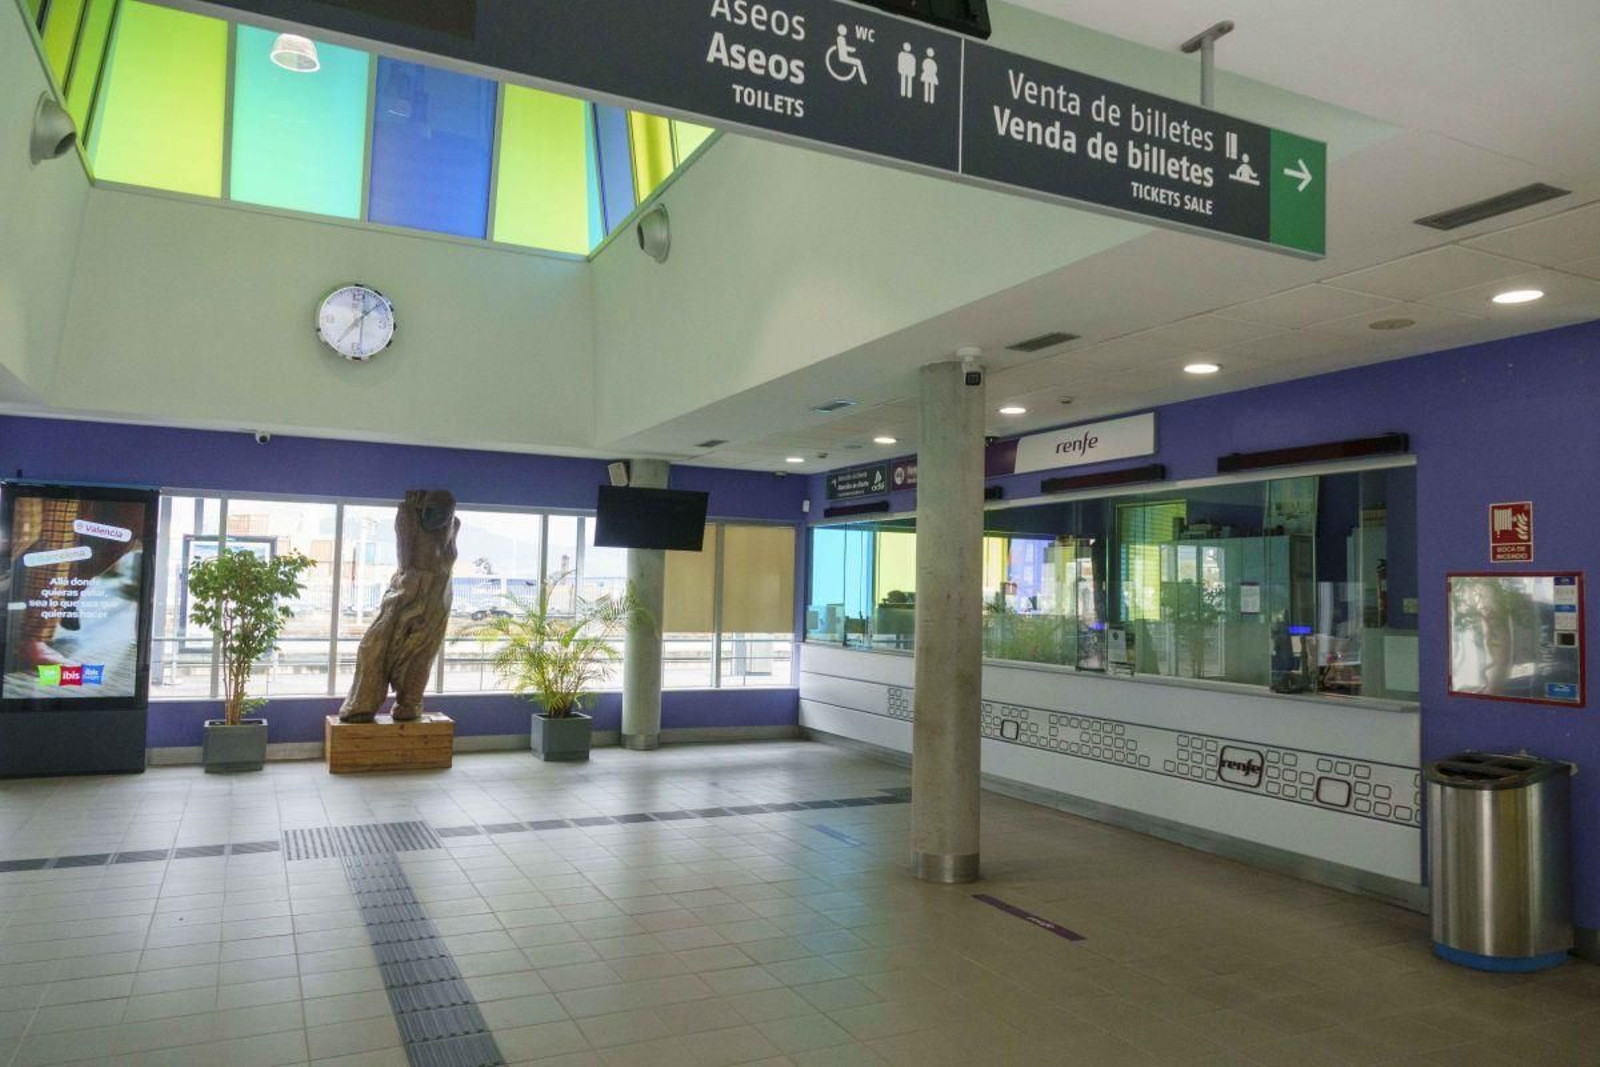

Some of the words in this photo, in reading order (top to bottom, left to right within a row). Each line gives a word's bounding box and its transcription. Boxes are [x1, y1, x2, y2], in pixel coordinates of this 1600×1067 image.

[710, 0, 805, 41] Aseos
[855, 25, 875, 43] WC
[706, 31, 805, 84] Aseos
[732, 84, 804, 118] TOILETS
[1008, 69, 1080, 116] Venta
[1091, 95, 1121, 126] de
[1132, 104, 1214, 152] billetes
[993, 105, 1077, 154] Venda
[1087, 132, 1119, 164] de
[1128, 140, 1214, 188] billetes
[1131, 181, 1181, 208] TICKETS
[1184, 194, 1214, 215] SALE
[1055, 430, 1098, 457] renfe
[86, 524, 124, 538] Valencia
[28, 599, 48, 607] sea
[49, 599, 59, 607] lo
[60, 600, 80, 609] que
[41, 588, 79, 597] quieras
[41, 610, 79, 619] quieras
[62, 670, 81, 680] ibis
[1220, 758, 1263, 777] renfe
